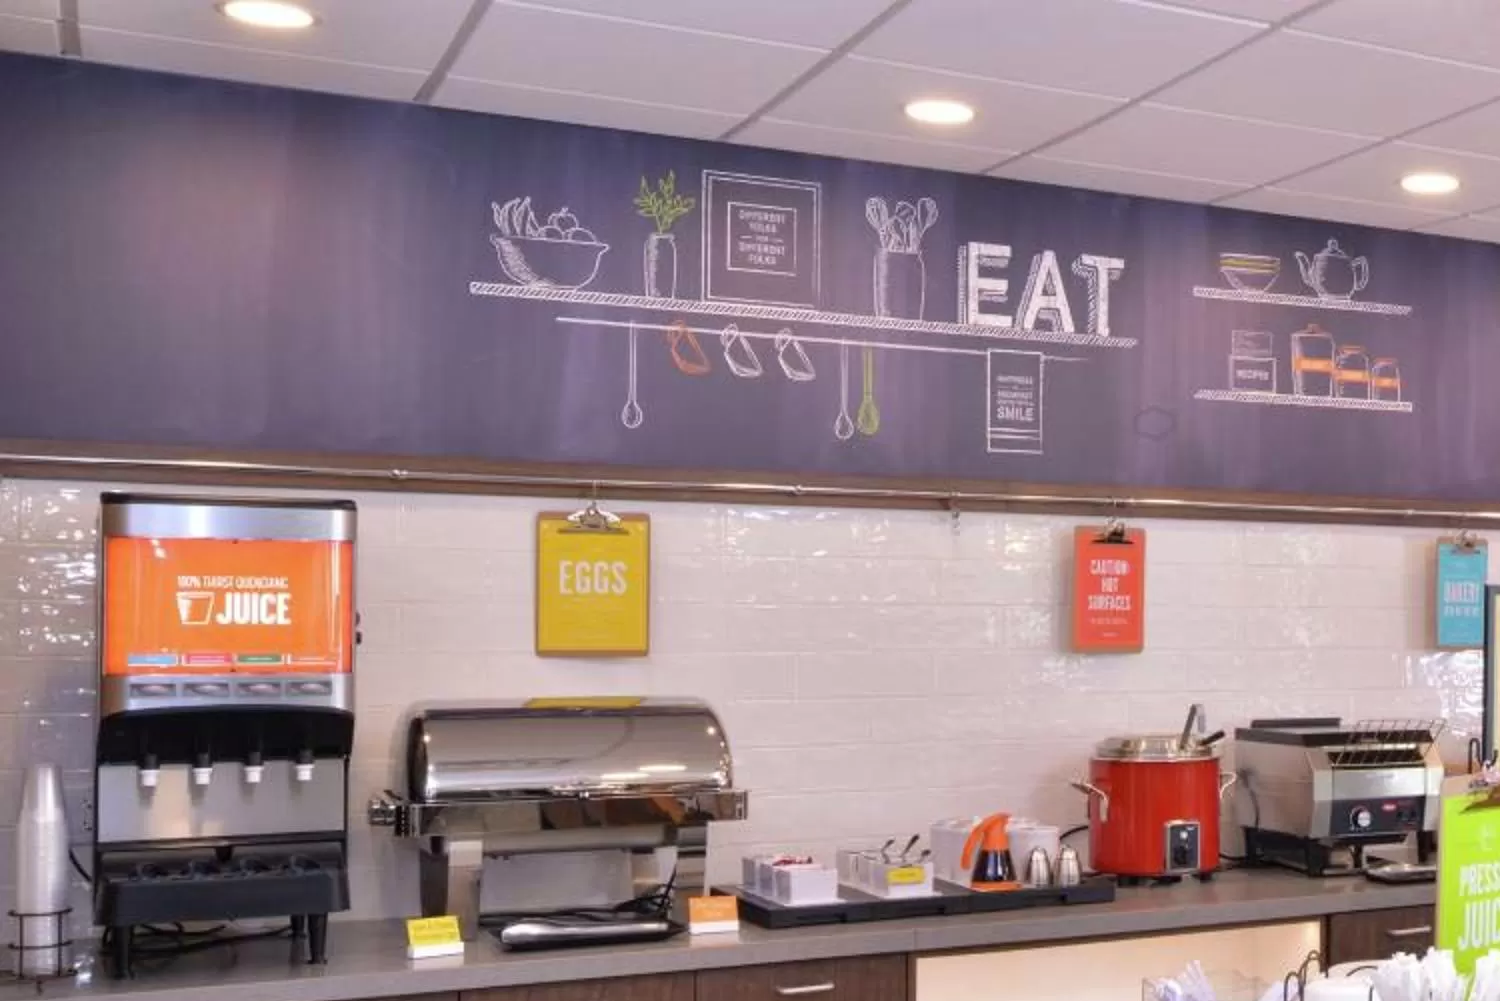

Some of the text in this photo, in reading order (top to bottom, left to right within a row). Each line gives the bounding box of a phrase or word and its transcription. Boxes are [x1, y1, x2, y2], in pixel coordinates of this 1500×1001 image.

[957, 241, 1125, 337] EAT
[996, 406, 1035, 421] SMILE
[559, 560, 628, 596] EGGS
[1101, 576, 1119, 593] HOT
[216, 592, 292, 624] JUICE
